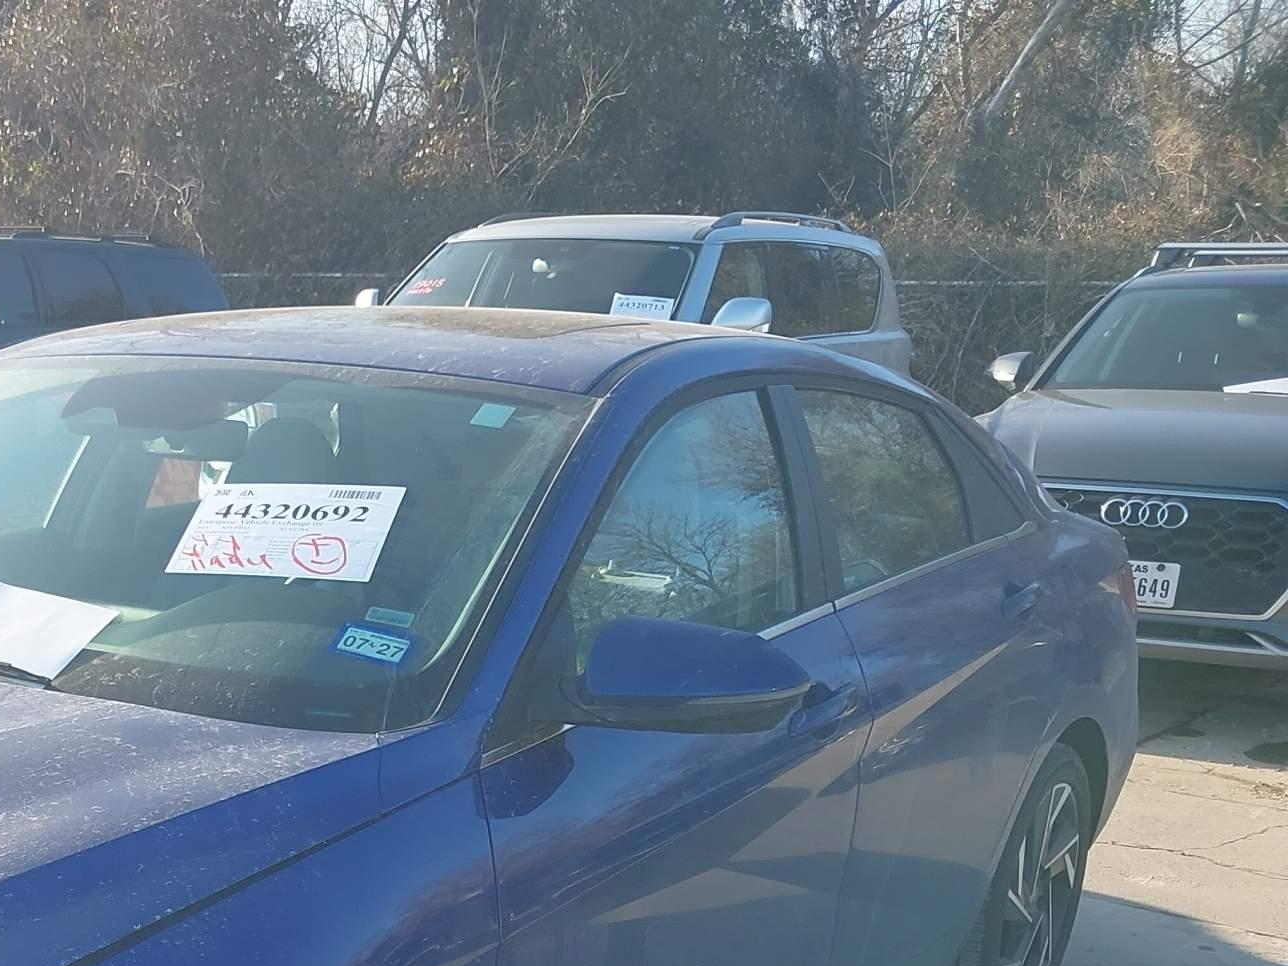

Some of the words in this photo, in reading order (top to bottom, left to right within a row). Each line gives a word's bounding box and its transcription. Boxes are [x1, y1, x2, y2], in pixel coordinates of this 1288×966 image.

[215, 503, 370, 522] 44320692
[1130, 564, 1149, 574] AS
[1133, 577, 1170, 599] 649
[343, 635, 370, 650] 07
[375, 643, 404, 658] 27
